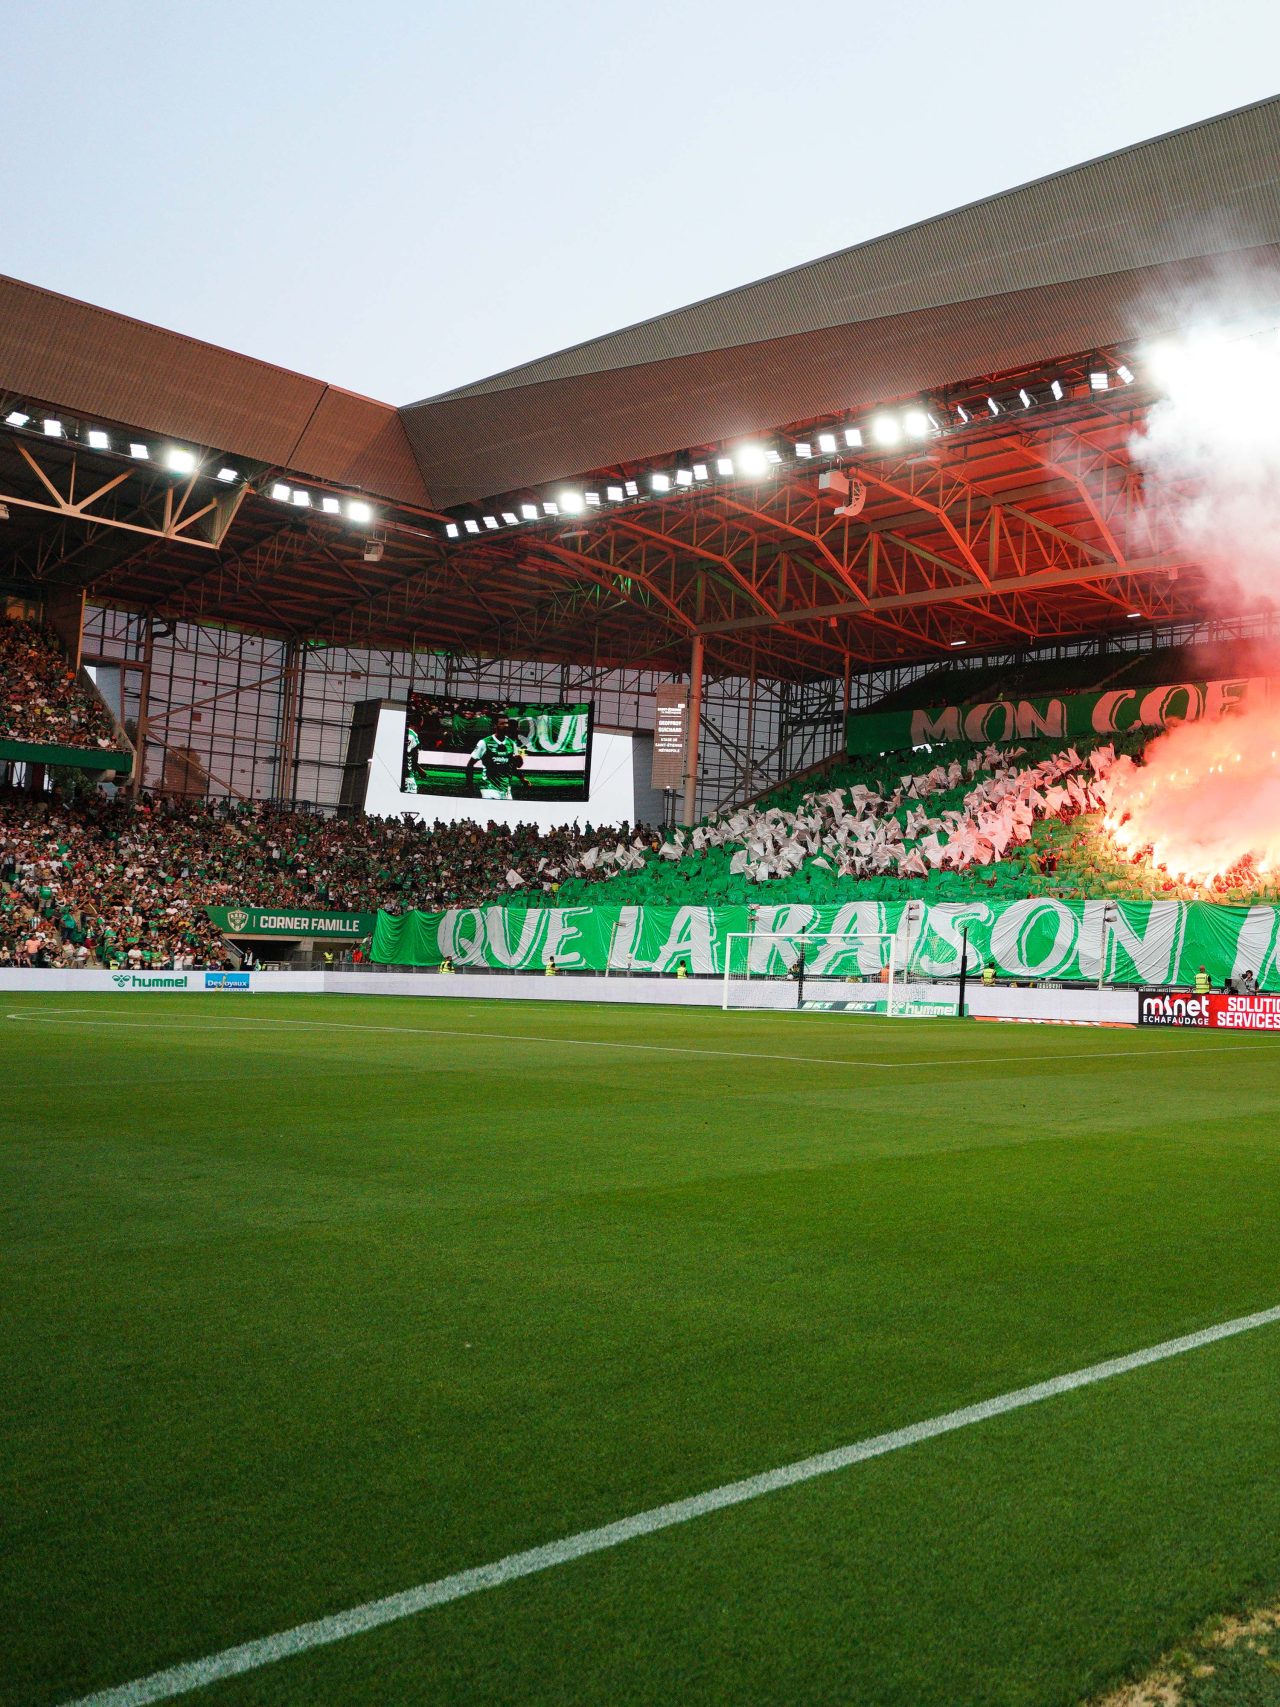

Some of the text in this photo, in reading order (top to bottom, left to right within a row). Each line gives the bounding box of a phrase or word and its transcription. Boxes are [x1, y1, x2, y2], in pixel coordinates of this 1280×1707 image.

[911, 699, 1067, 746] MON
[260, 915, 359, 932] CORNER FAMILLE
[437, 906, 593, 969] QUE
[609, 905, 720, 974] LA
[750, 898, 1187, 984] RAISON
[132, 975, 188, 988] hummel
[905, 1003, 957, 1016] hummel
[1143, 1015, 1209, 1026] ECHAFAUDAGE
